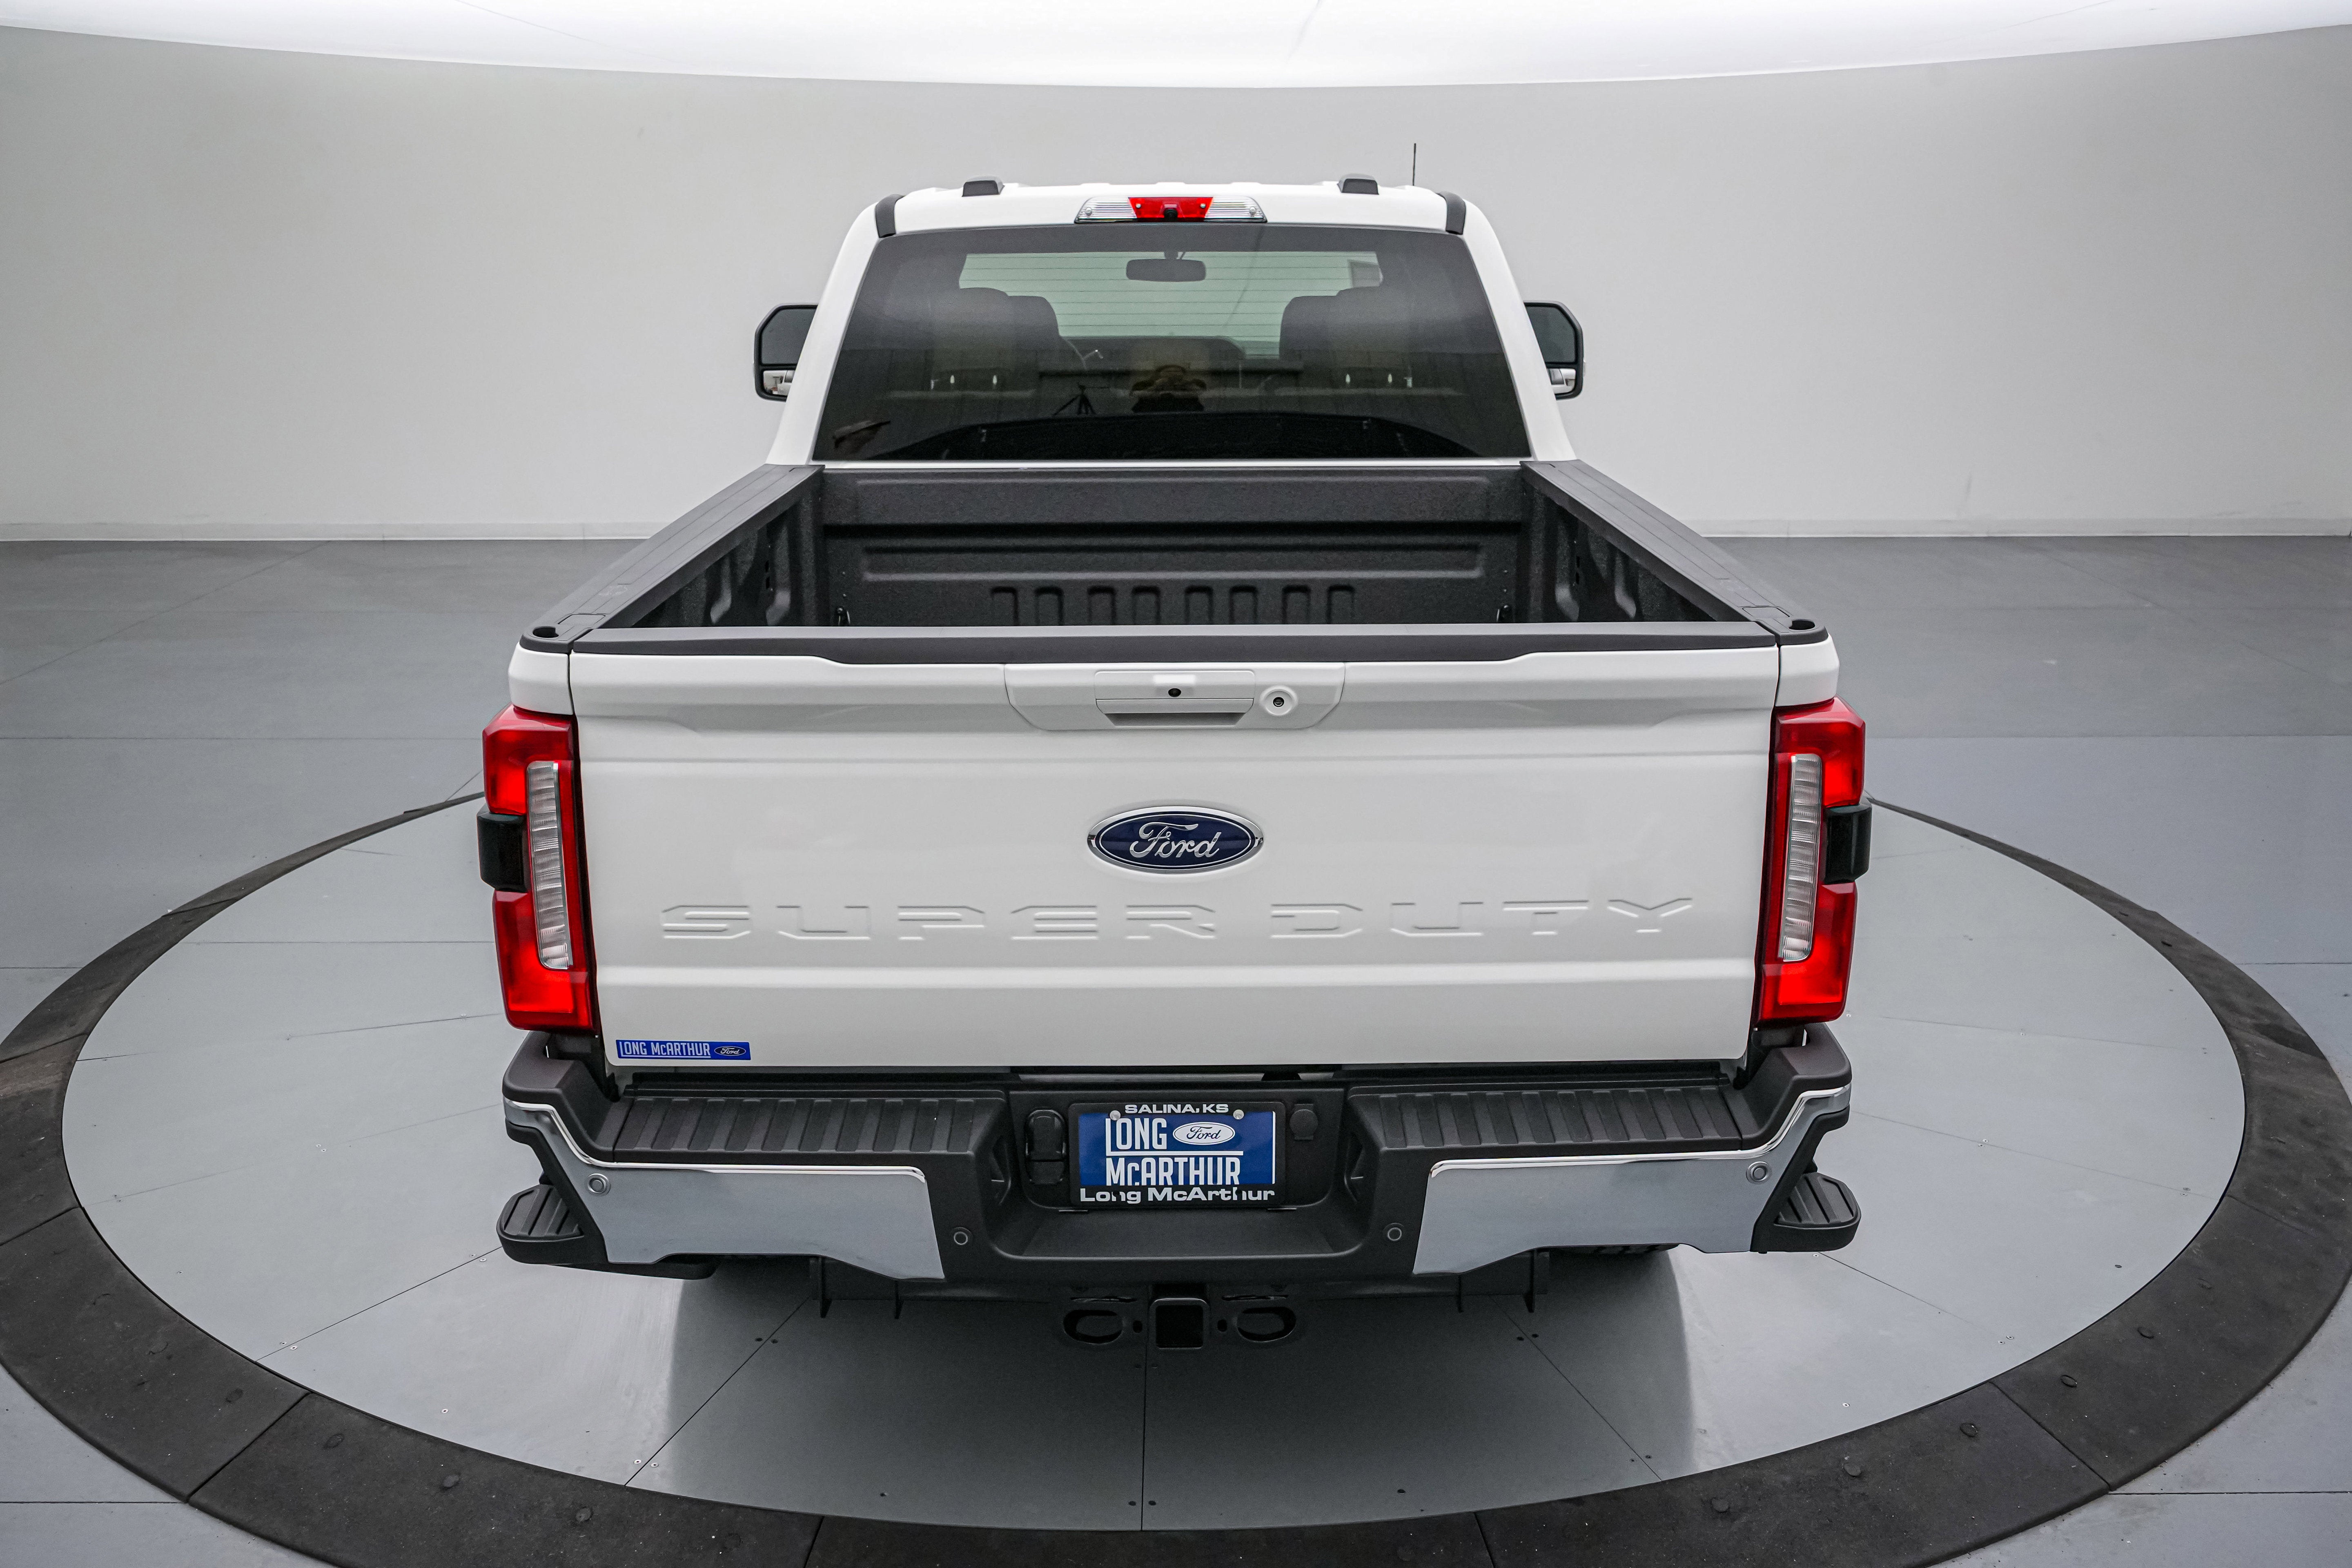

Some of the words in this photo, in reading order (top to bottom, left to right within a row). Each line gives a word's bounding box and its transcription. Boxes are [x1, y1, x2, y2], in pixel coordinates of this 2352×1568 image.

[1130, 822, 1222, 858] Ford
[661, 905, 1216, 940] SUPER
[1270, 898, 1693, 938] DUTY
[619, 1041, 647, 1056] LONG
[651, 1042, 711, 1056] McARTHUR
[1125, 1104, 1200, 1114] SALINA,
[1203, 1104, 1229, 1113] KS
[1105, 1118, 1167, 1155] LONG
[1186, 1126, 1221, 1140] Ford
[1106, 1157, 1241, 1186] McARTHUR
[1080, 1188, 1141, 1204] Long
[1148, 1187, 1275, 1201] McArthur
